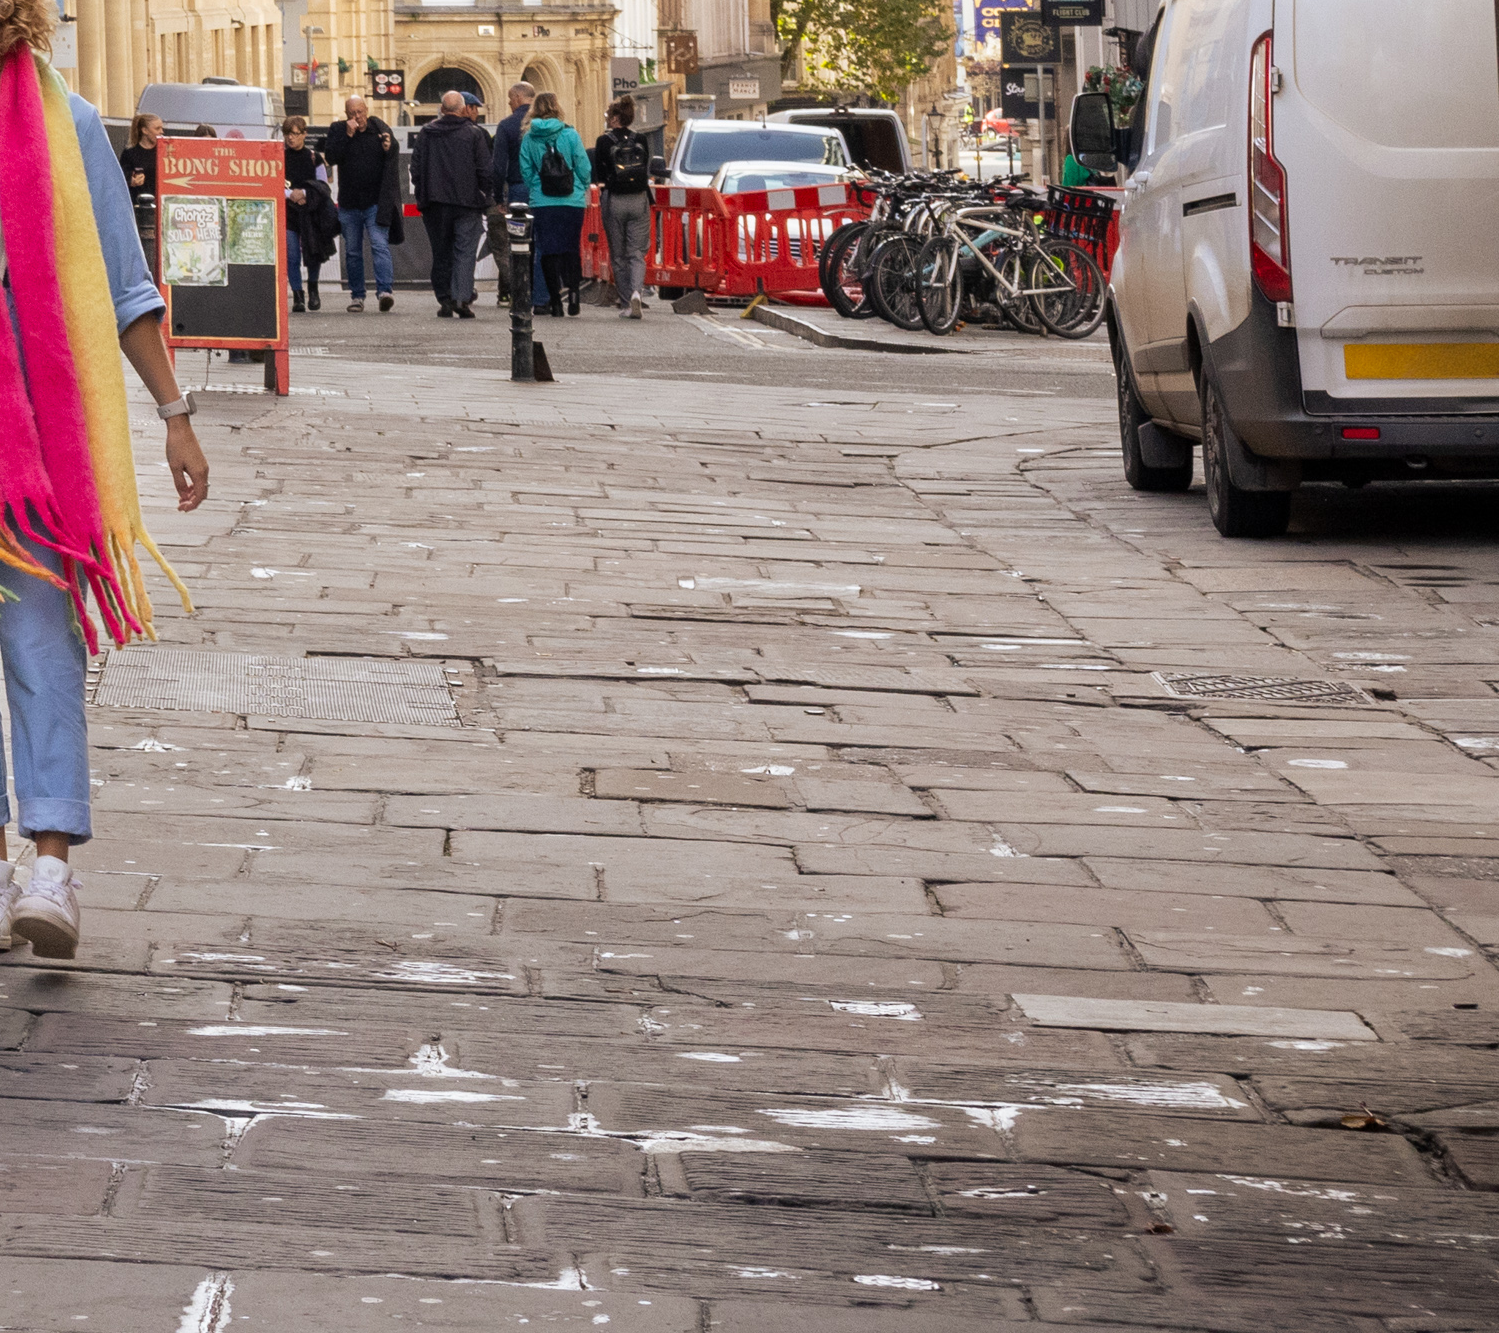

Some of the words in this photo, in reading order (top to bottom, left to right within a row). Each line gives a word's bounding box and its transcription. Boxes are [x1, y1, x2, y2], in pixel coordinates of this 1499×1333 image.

[1052, 8, 1075, 17] FLIGHT
[1076, 8, 1090, 17] CLUB
[613, 77, 638, 89] Pho
[212, 147, 237, 157] THE
[163, 156, 219, 176] BONG
[228, 159, 283, 178] SHOP
[174, 207, 216, 228] Chongz
[167, 229, 194, 242] SOLD
[1329, 256, 1423, 266] TRANSIT
